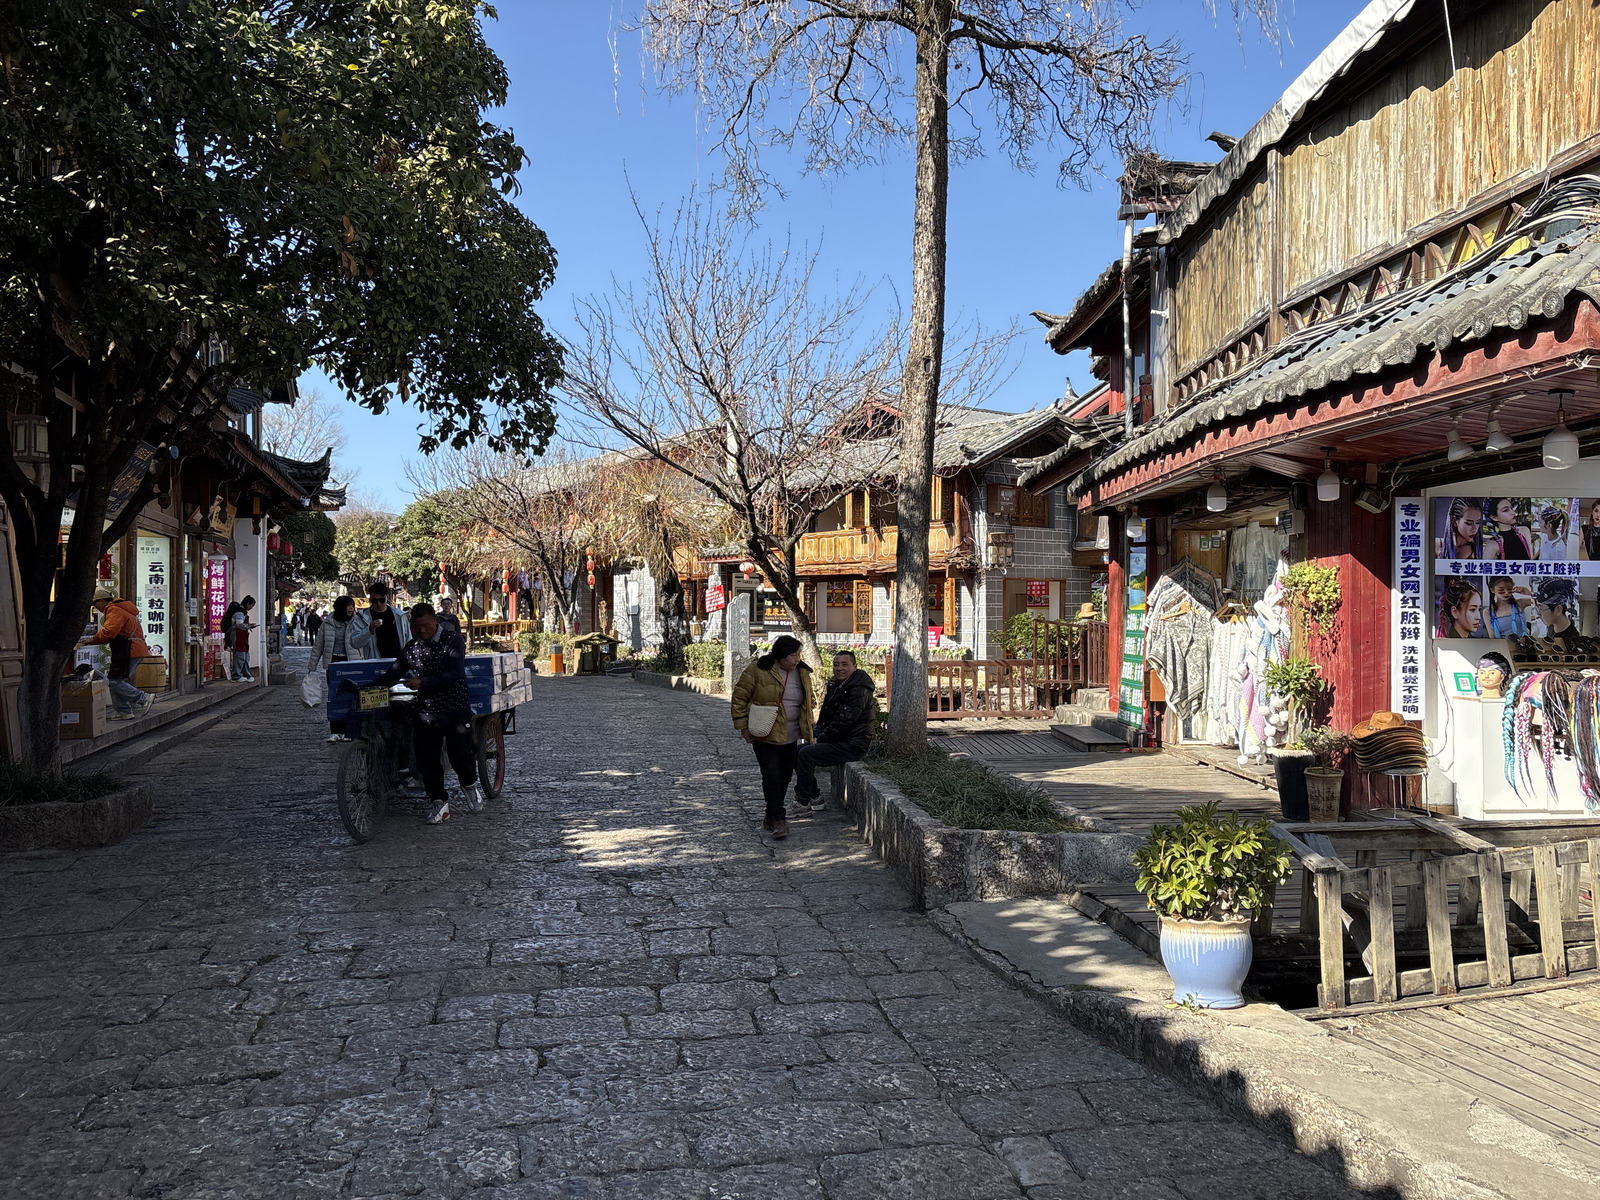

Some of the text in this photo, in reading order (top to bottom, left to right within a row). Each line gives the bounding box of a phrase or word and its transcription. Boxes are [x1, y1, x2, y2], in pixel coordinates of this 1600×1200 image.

[147, 561, 165, 635] 云南粒咖啡
[210, 560, 226, 617] 烤鲜花饼
[1449, 561, 1581, 575] 专业编男女网红脏辫
[1399, 502, 1421, 714] 专业编男女网红脏辫 洗头睡觉不影响
